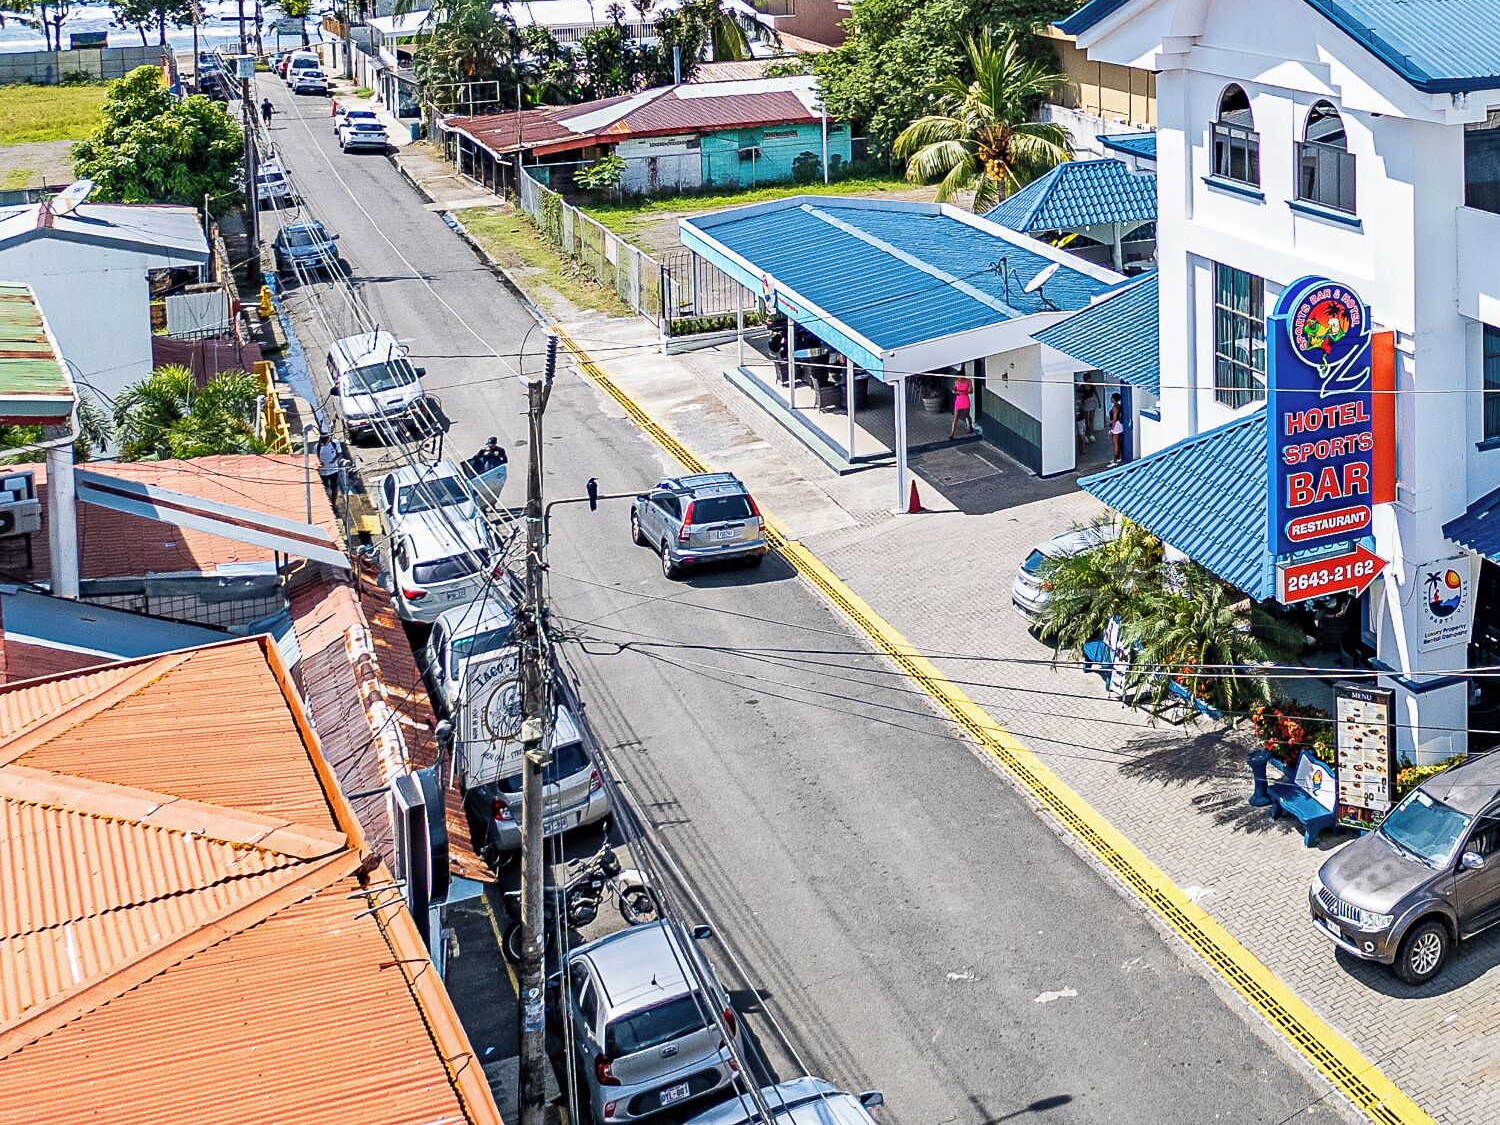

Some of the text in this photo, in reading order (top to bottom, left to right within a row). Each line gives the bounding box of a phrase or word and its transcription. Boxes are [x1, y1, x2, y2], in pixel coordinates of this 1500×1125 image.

[1295, 288, 1360, 351] SPORTS BAR & HOTEL
[1285, 401, 1369, 436] HOTEL
[1284, 432, 1374, 465] SPORTS
[1286, 461, 1370, 508] BAR
[1292, 511, 1367, 537] RESTAURANT
[1287, 559, 1374, 593] 2643-2162
[1443, 623, 1467, 634] Property
[472, 658, 519, 687] TACO-J
[1351, 691, 1372, 701] MENU
